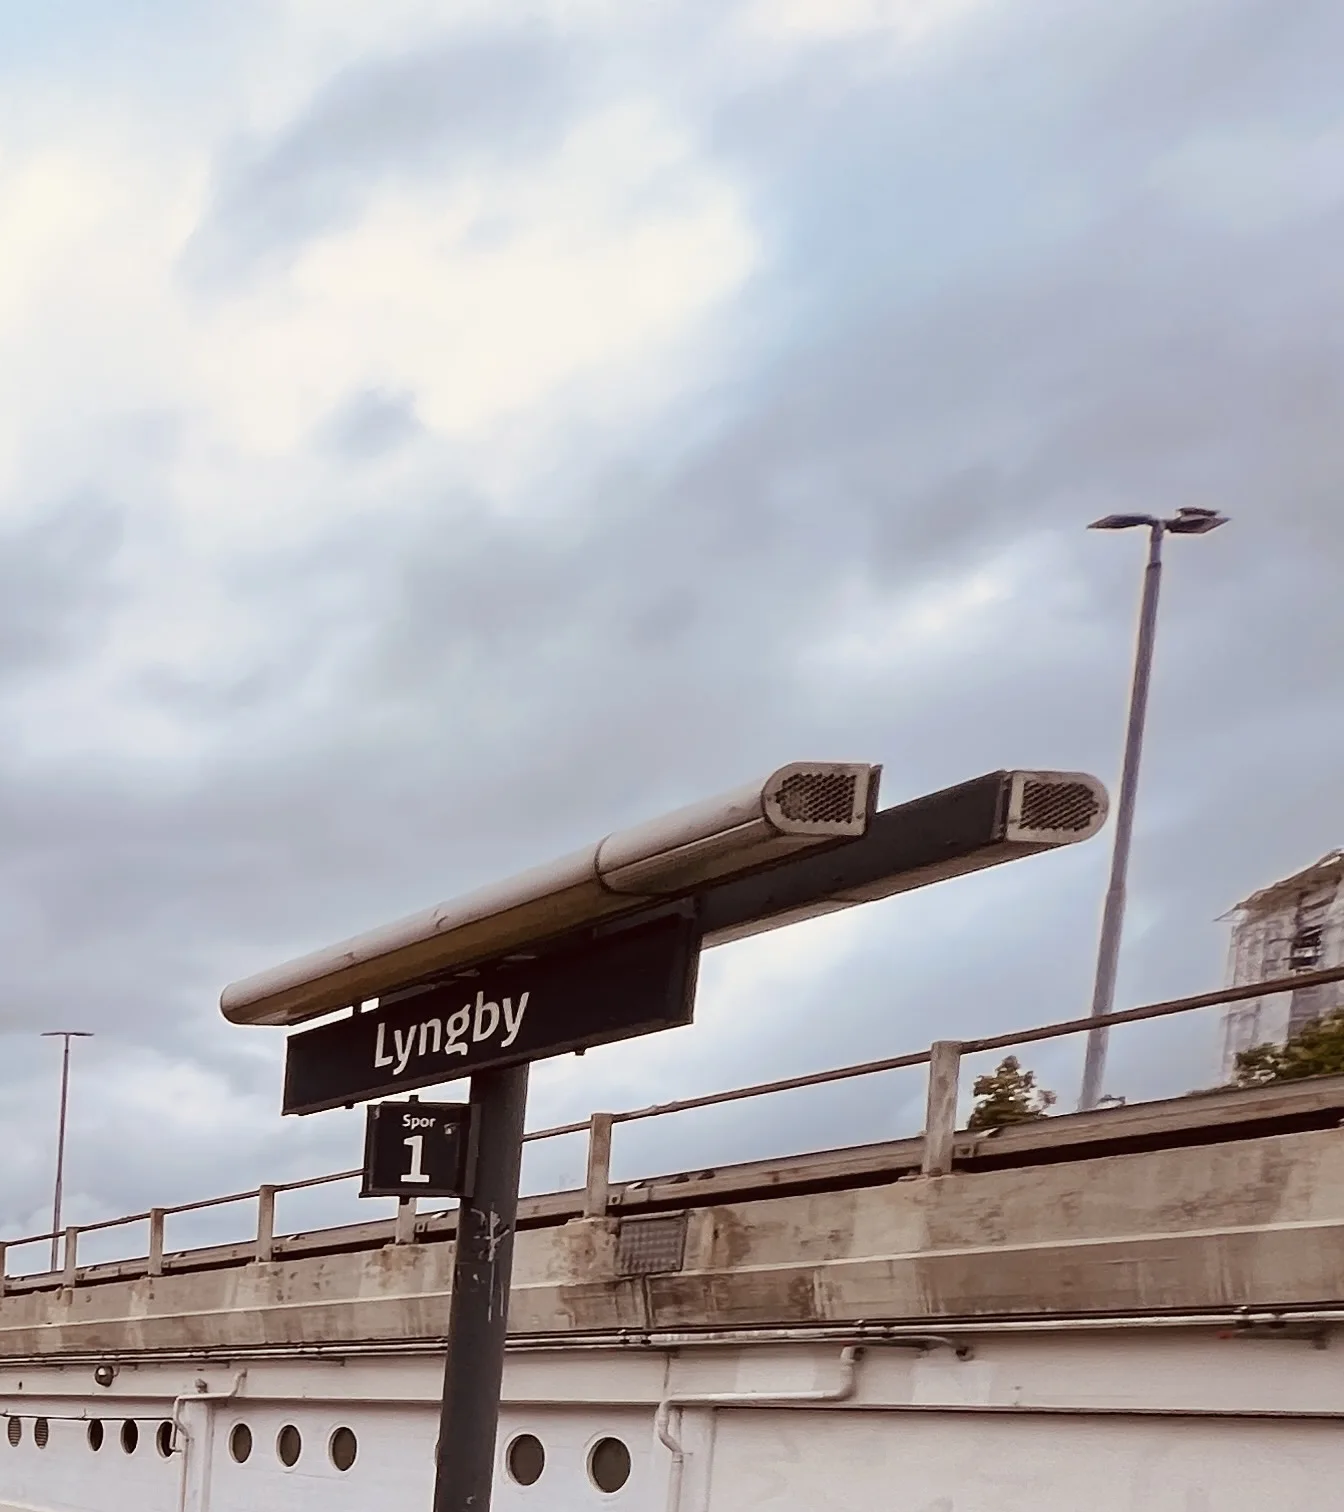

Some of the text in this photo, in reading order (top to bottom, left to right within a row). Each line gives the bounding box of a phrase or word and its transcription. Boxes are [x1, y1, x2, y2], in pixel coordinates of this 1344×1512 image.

[374, 990, 531, 1076] Lyngby
[402, 1114, 436, 1130] Spor
[400, 1135, 430, 1183] 1
